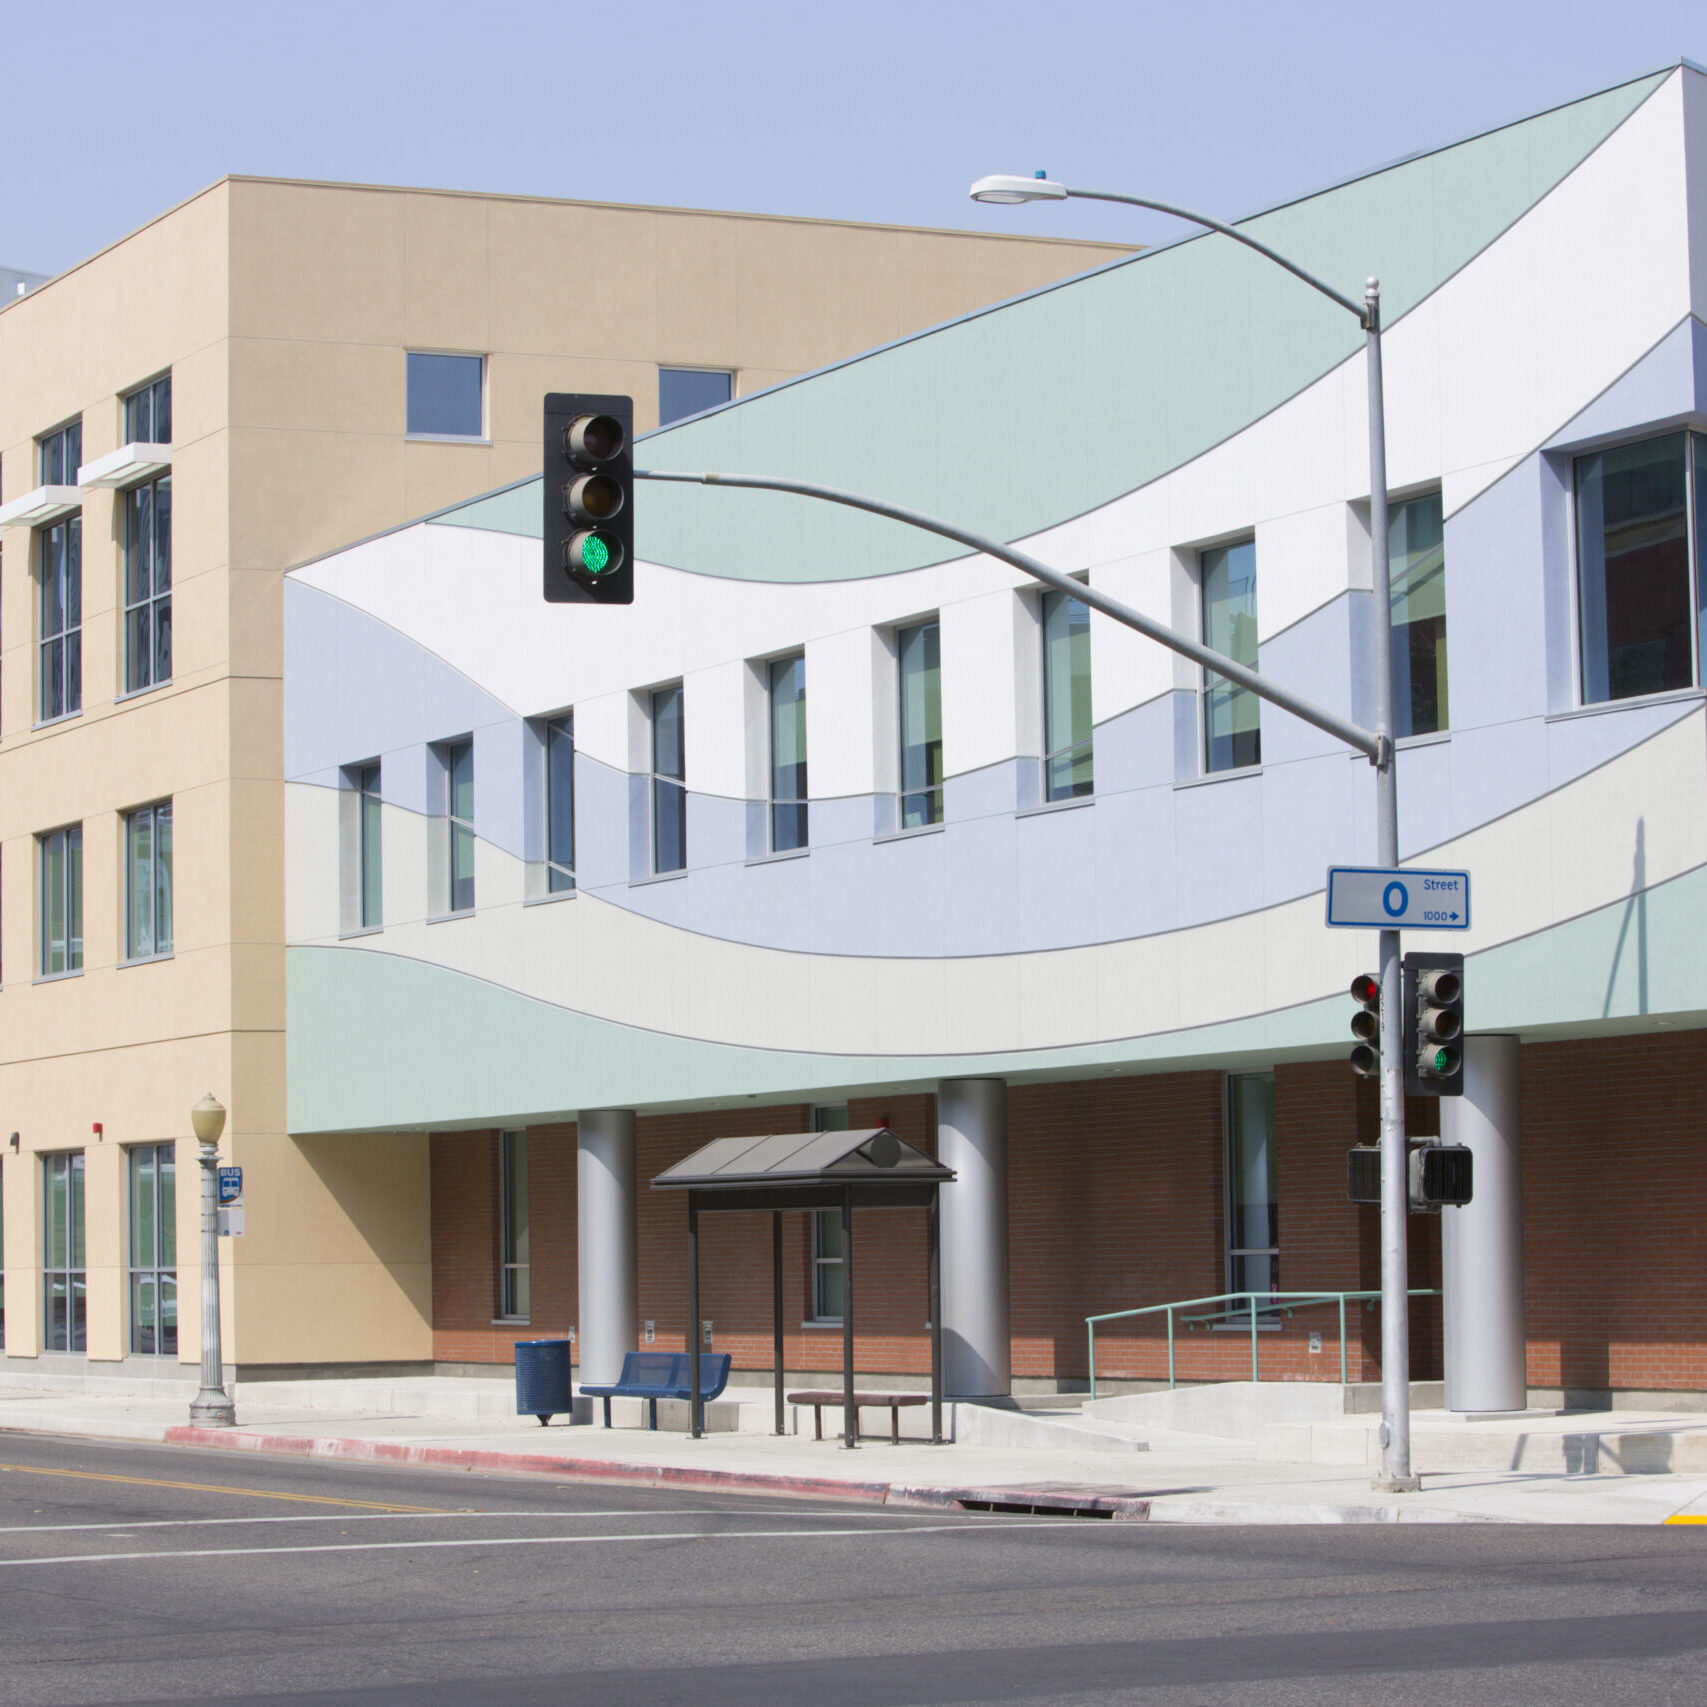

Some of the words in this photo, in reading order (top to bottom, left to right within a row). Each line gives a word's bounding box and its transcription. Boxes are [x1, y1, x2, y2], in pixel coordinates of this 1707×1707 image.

[1383, 881, 1408, 917] O
[1423, 879, 1459, 890] Street
[1423, 911, 1447, 921] 1000
[220, 1168, 241, 1176] BUS
